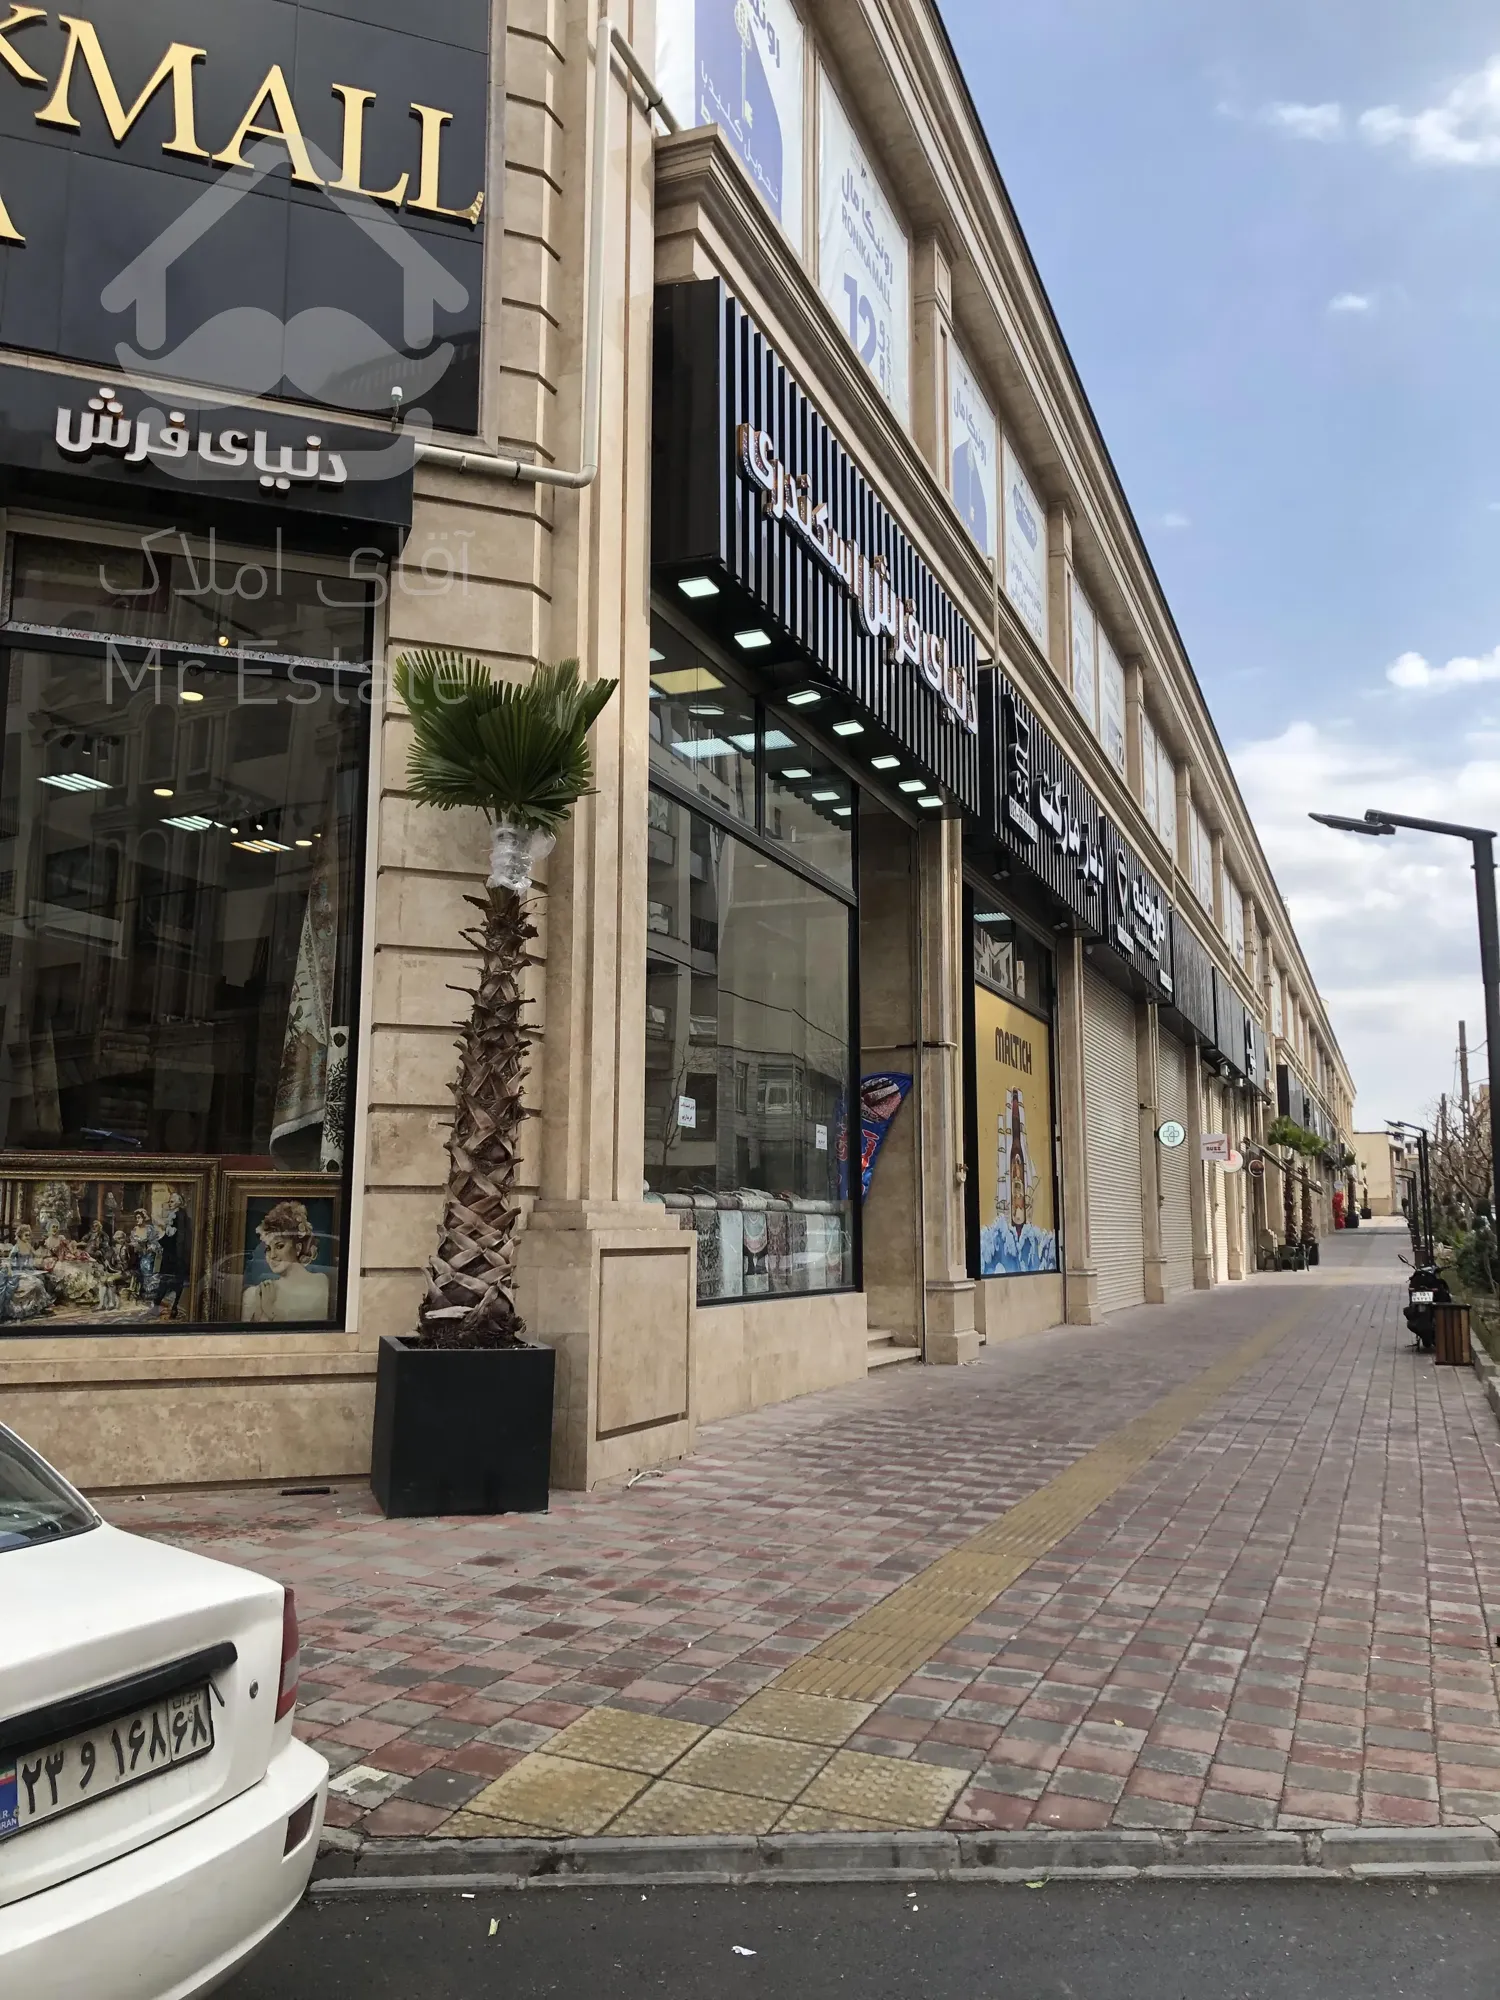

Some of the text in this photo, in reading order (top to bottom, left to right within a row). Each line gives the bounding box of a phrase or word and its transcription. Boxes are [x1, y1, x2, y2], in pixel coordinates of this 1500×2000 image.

[55, 386, 349, 492] دنیای فرش
[736, 422, 978, 735] دنیای فرش اسکندری
[994, 1026, 1033, 1076] MALTICH
